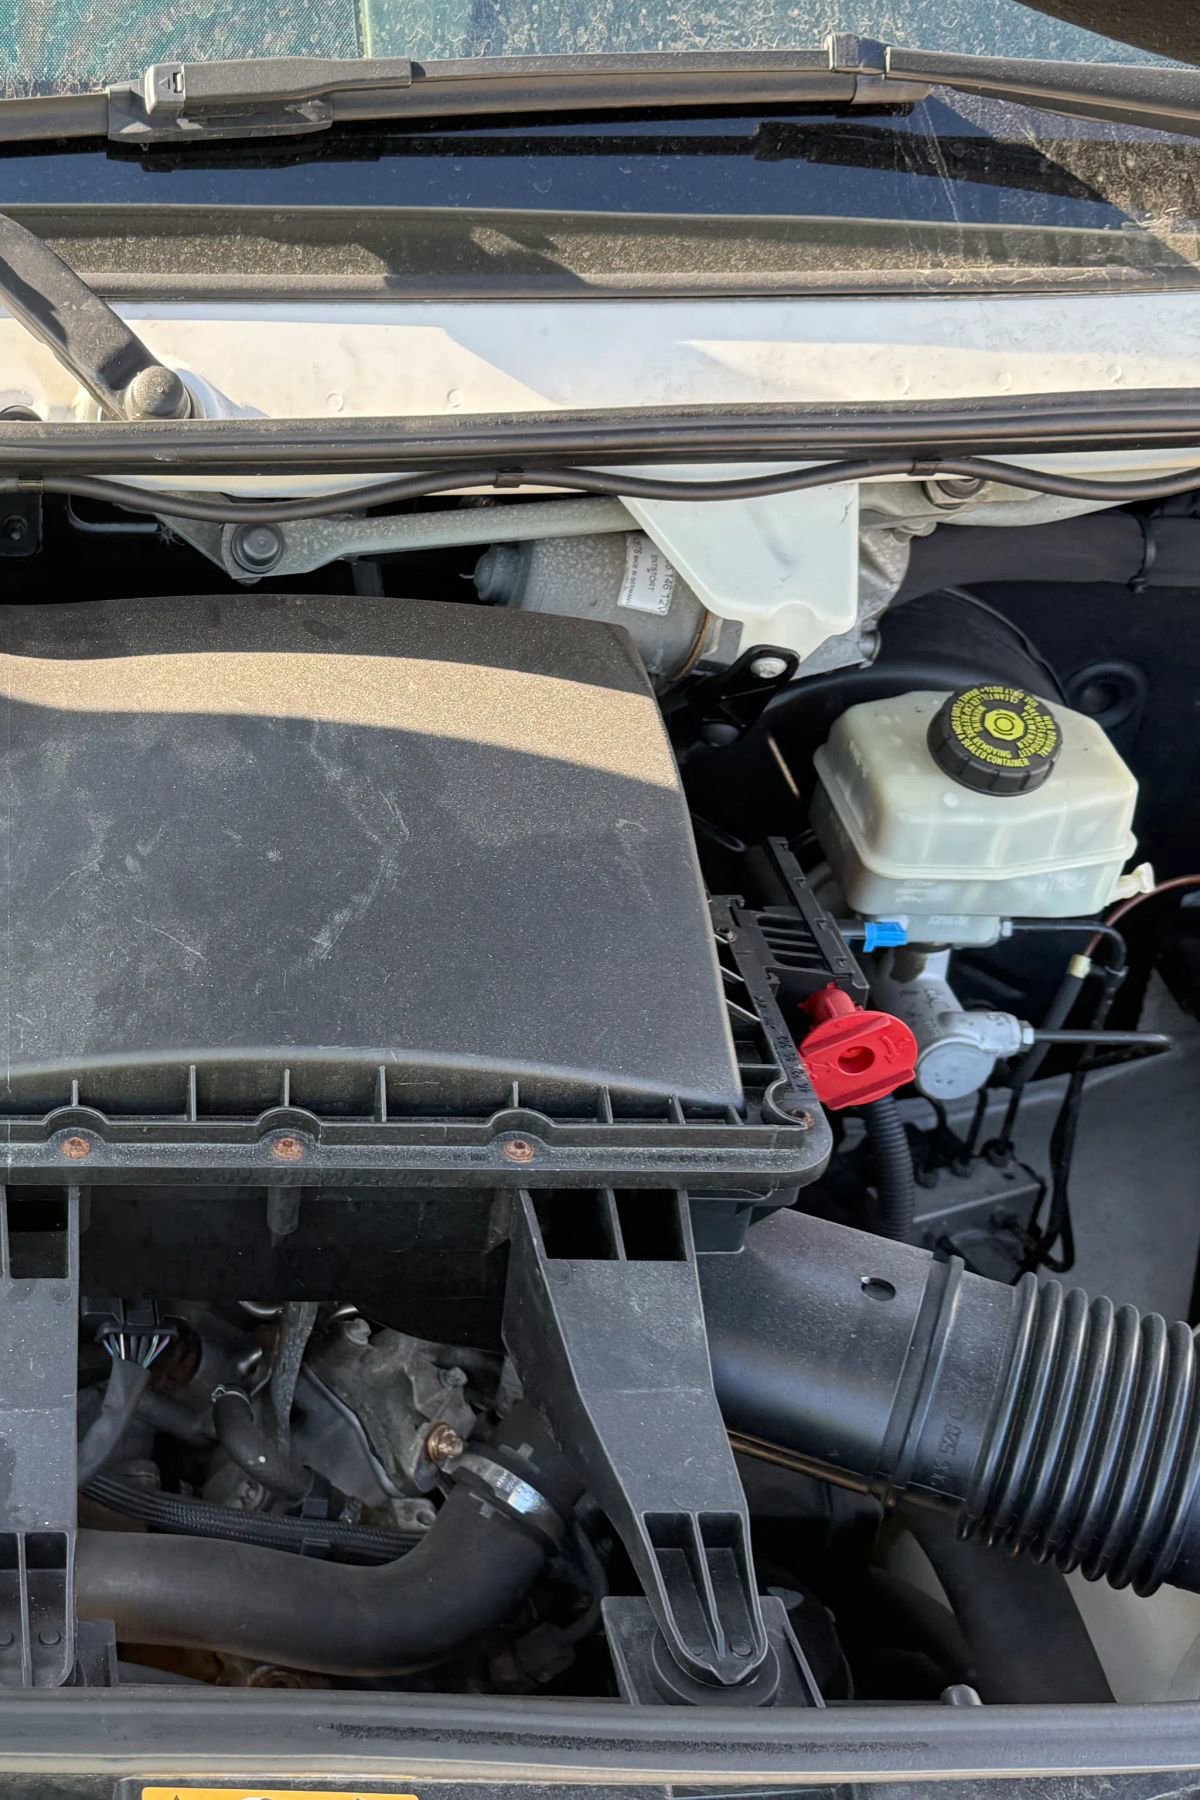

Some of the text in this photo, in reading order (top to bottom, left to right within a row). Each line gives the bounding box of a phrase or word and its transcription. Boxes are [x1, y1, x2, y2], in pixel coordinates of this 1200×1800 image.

[961, 739, 987, 759] SEALED
[986, 755, 1030, 767] CONTAINER
[972, 736, 1012, 758] REMOVING
